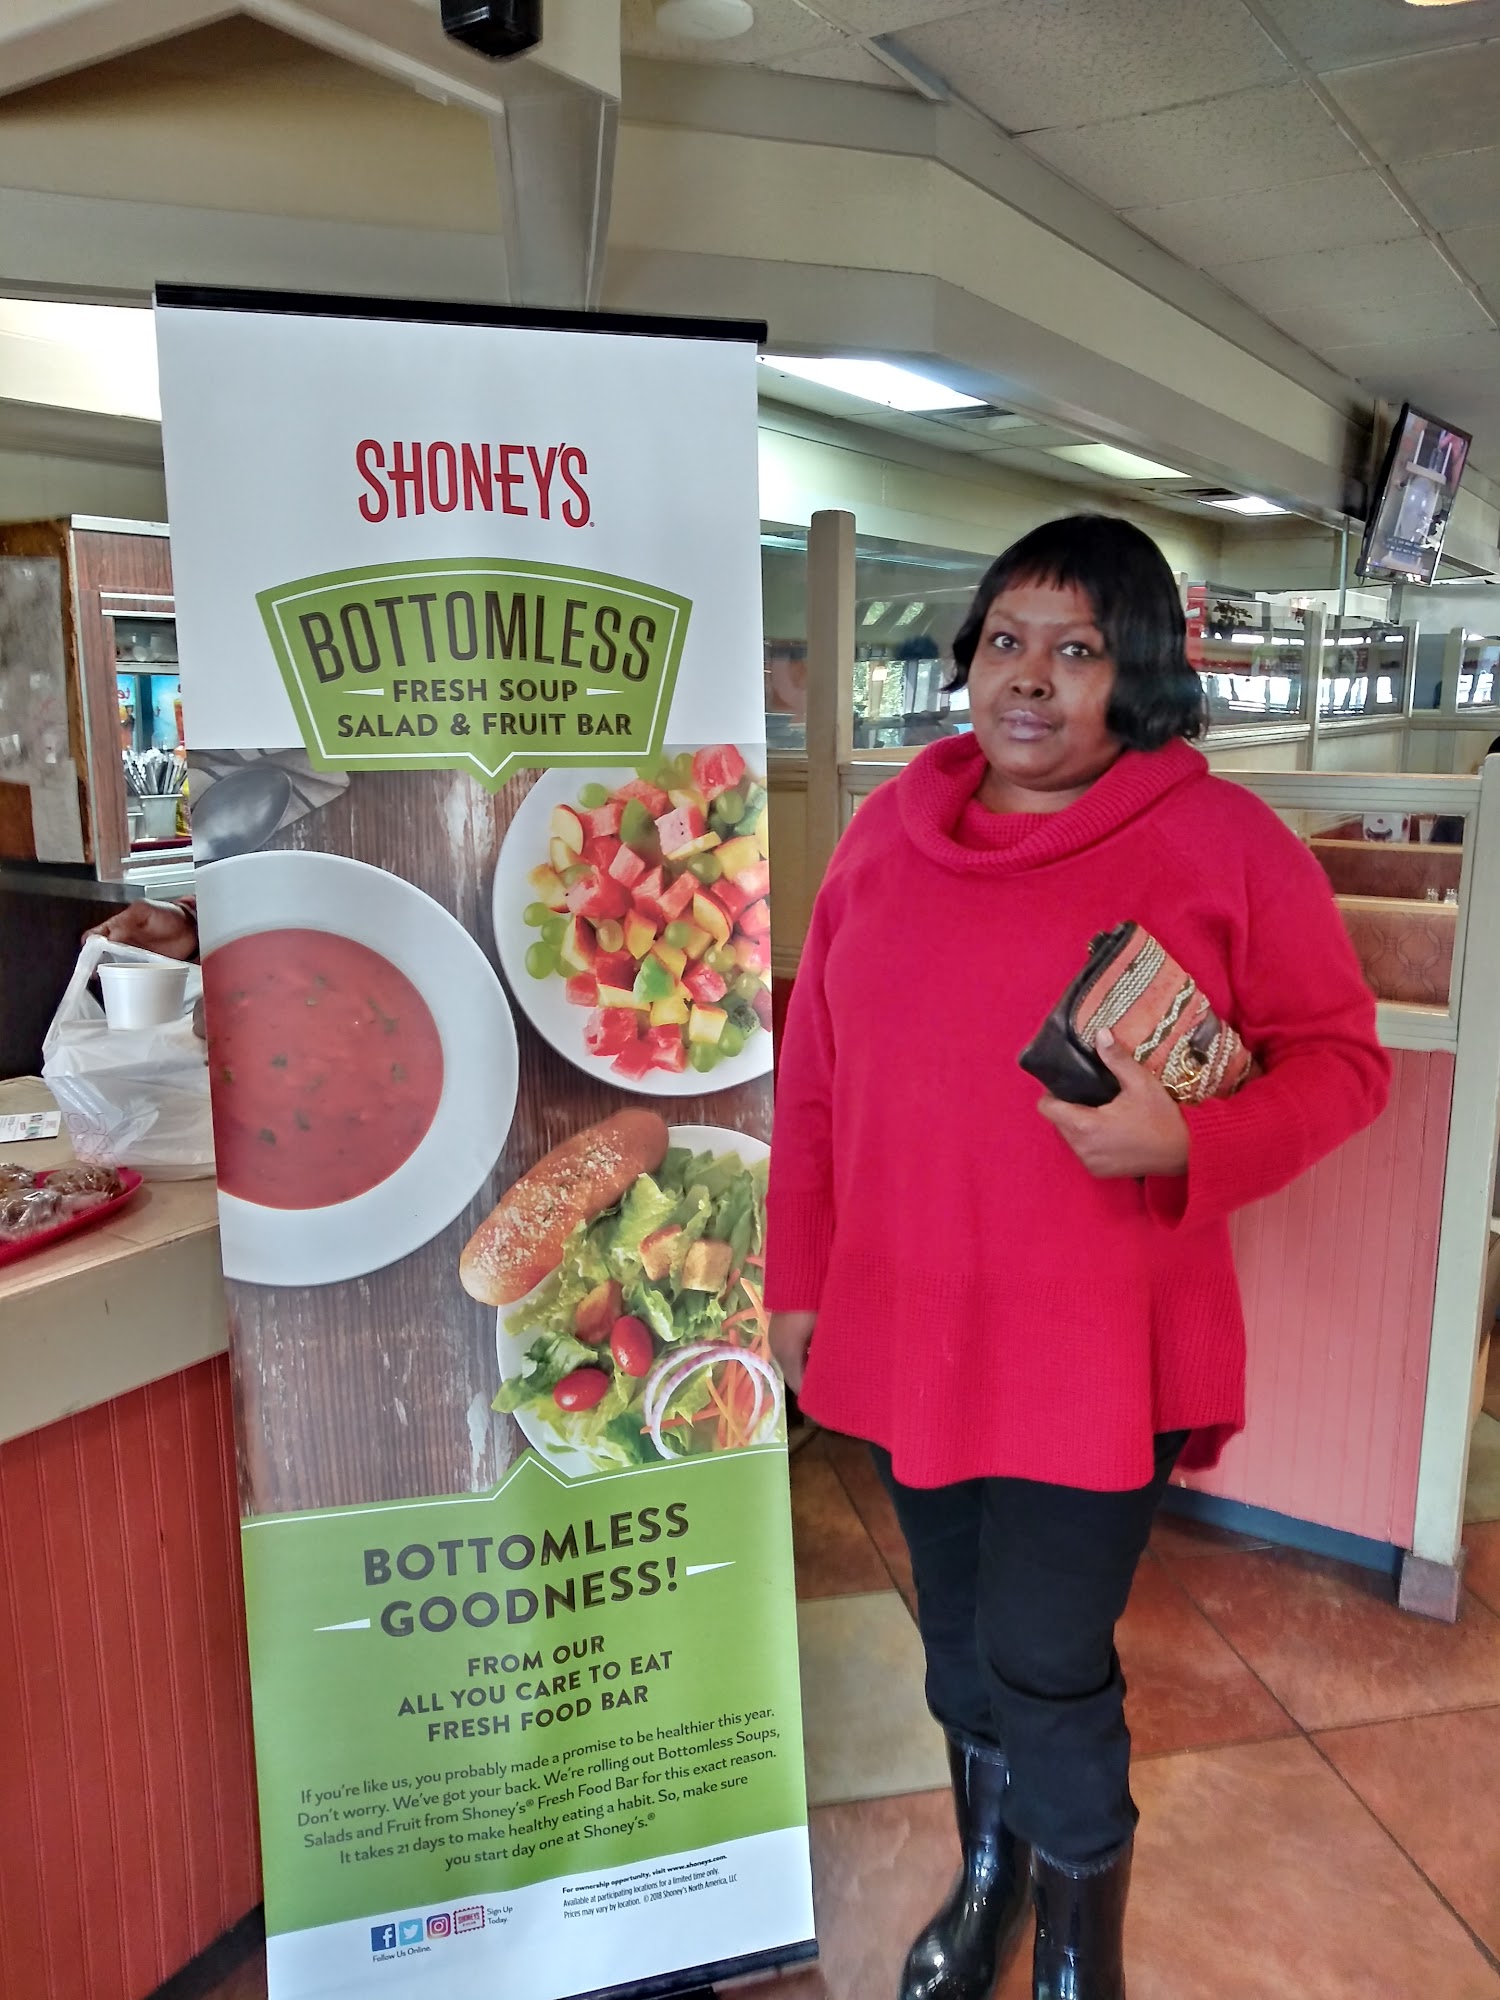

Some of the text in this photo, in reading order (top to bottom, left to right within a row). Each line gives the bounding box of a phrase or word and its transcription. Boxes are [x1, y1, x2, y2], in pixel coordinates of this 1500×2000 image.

[299, 591, 656, 684] BOTTOMLESS
[393, 679, 577, 702] FRESH SOUP
[338, 712, 632, 737] SALAD & FRUIT BAR
[364, 1502, 689, 1586] BOTTOMLESS
[380, 1556, 677, 1637] GOODNESS!
[468, 1635, 604, 1677] FROM OUR
[397, 1650, 672, 1716] ALL YOU CARE TO EAT
[428, 1685, 648, 1742] FRESH FOOD BAR
[298, 1727, 780, 1826] Don't worry. We've got your back. We're rolling out Bottomless Soups,
[301, 1707, 774, 1806] If you're like us, you probably made a promise to be healthier this year.
[304, 1829, 352, 1848] Salads
[357, 1822, 383, 1839] and
[387, 1817, 421, 1833] Fruit
[425, 1813, 459, 1827] from
[538, 1790, 575, 1809] Fresh
[578, 1779, 612, 1798] Food
[616, 1776, 640, 1790] Bar
[642, 1772, 662, 1784] for
[665, 1766, 689, 1781] this
[693, 1759, 727, 1775] exact
[730, 1750, 776, 1767] reason.
[340, 1775, 748, 1864] It takes 21 days to make healthy eating a habit. So, make sure
[445, 1855, 470, 1871] you
[474, 1848, 508, 1862] start
[512, 1842, 535, 1858] day
[539, 1837, 563, 1850] one
[567, 1831, 580, 1842] at
[563, 1896, 589, 1907] Available
[598, 1888, 632, 1902] participating
[634, 1882, 658, 1894] locations
[673, 1874, 692, 1884] limited
[693, 1872, 705, 1881] time
[564, 1909, 580, 1918] Prices
[582, 1908, 594, 1916] may
[596, 1904, 608, 1912] vary
[610, 1902, 616, 1911] by
[650, 1892, 662, 1901] 2018
[663, 1887, 687, 1898] Shoney's
[689, 1883, 704, 1892] North
[705, 1878, 728, 1889] America,
[729, 1874, 737, 1882] LLC
[575, 1881, 610, 1892] ownership
[611, 1872, 651, 1885] opportunity,
[487, 1908, 501, 1916] Sign
[373, 1952, 395, 1962] Follow
